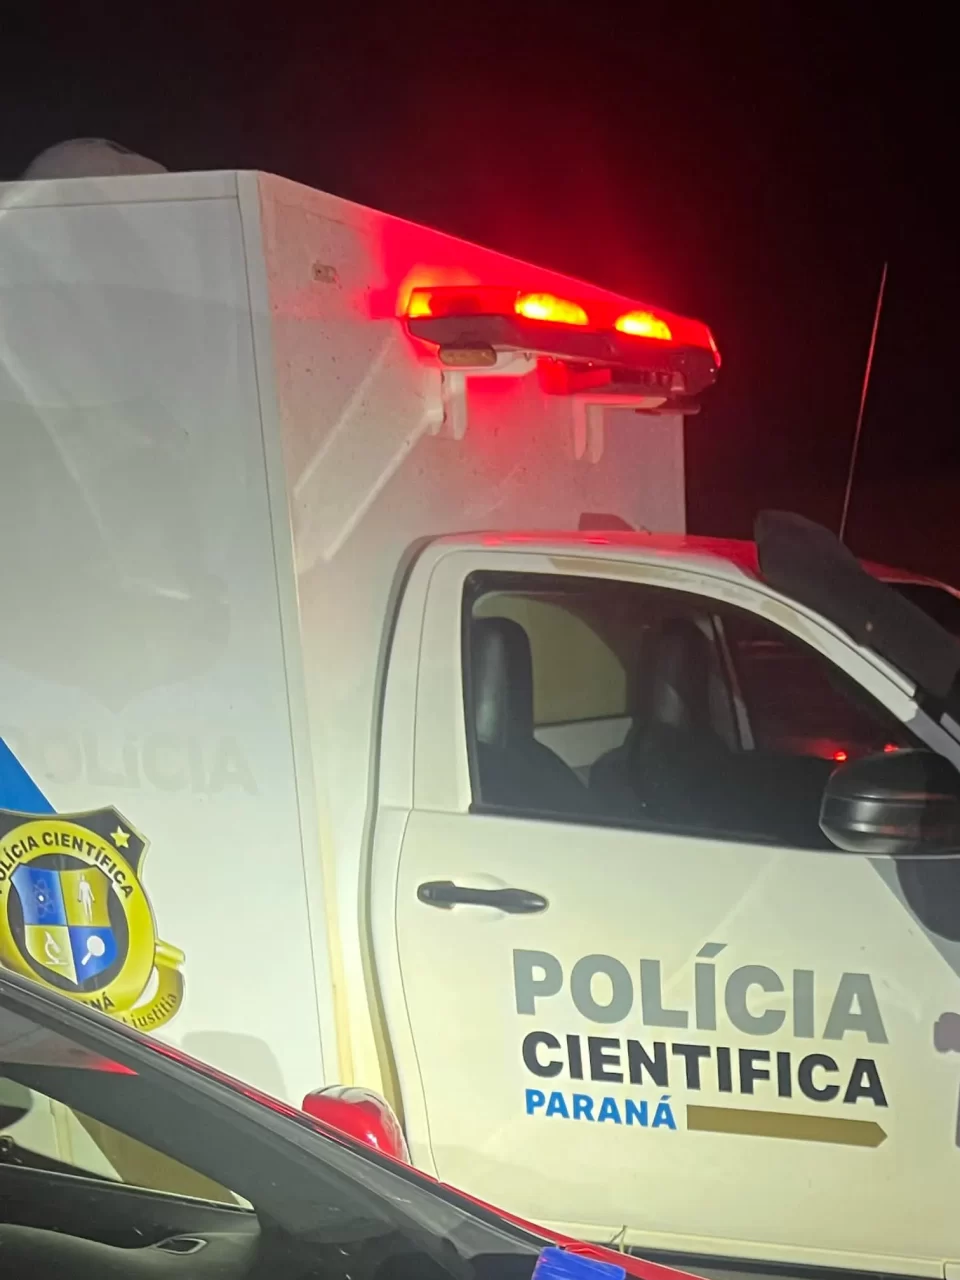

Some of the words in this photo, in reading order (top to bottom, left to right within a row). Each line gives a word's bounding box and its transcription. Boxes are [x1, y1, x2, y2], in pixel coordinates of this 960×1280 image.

[42, 832, 134, 898] CIENTÍFICA
[512, 942, 889, 1044] POLÍCIA
[522, 1031, 889, 1107] CIENTIFICA
[525, 1088, 677, 1130] PARANÁ
